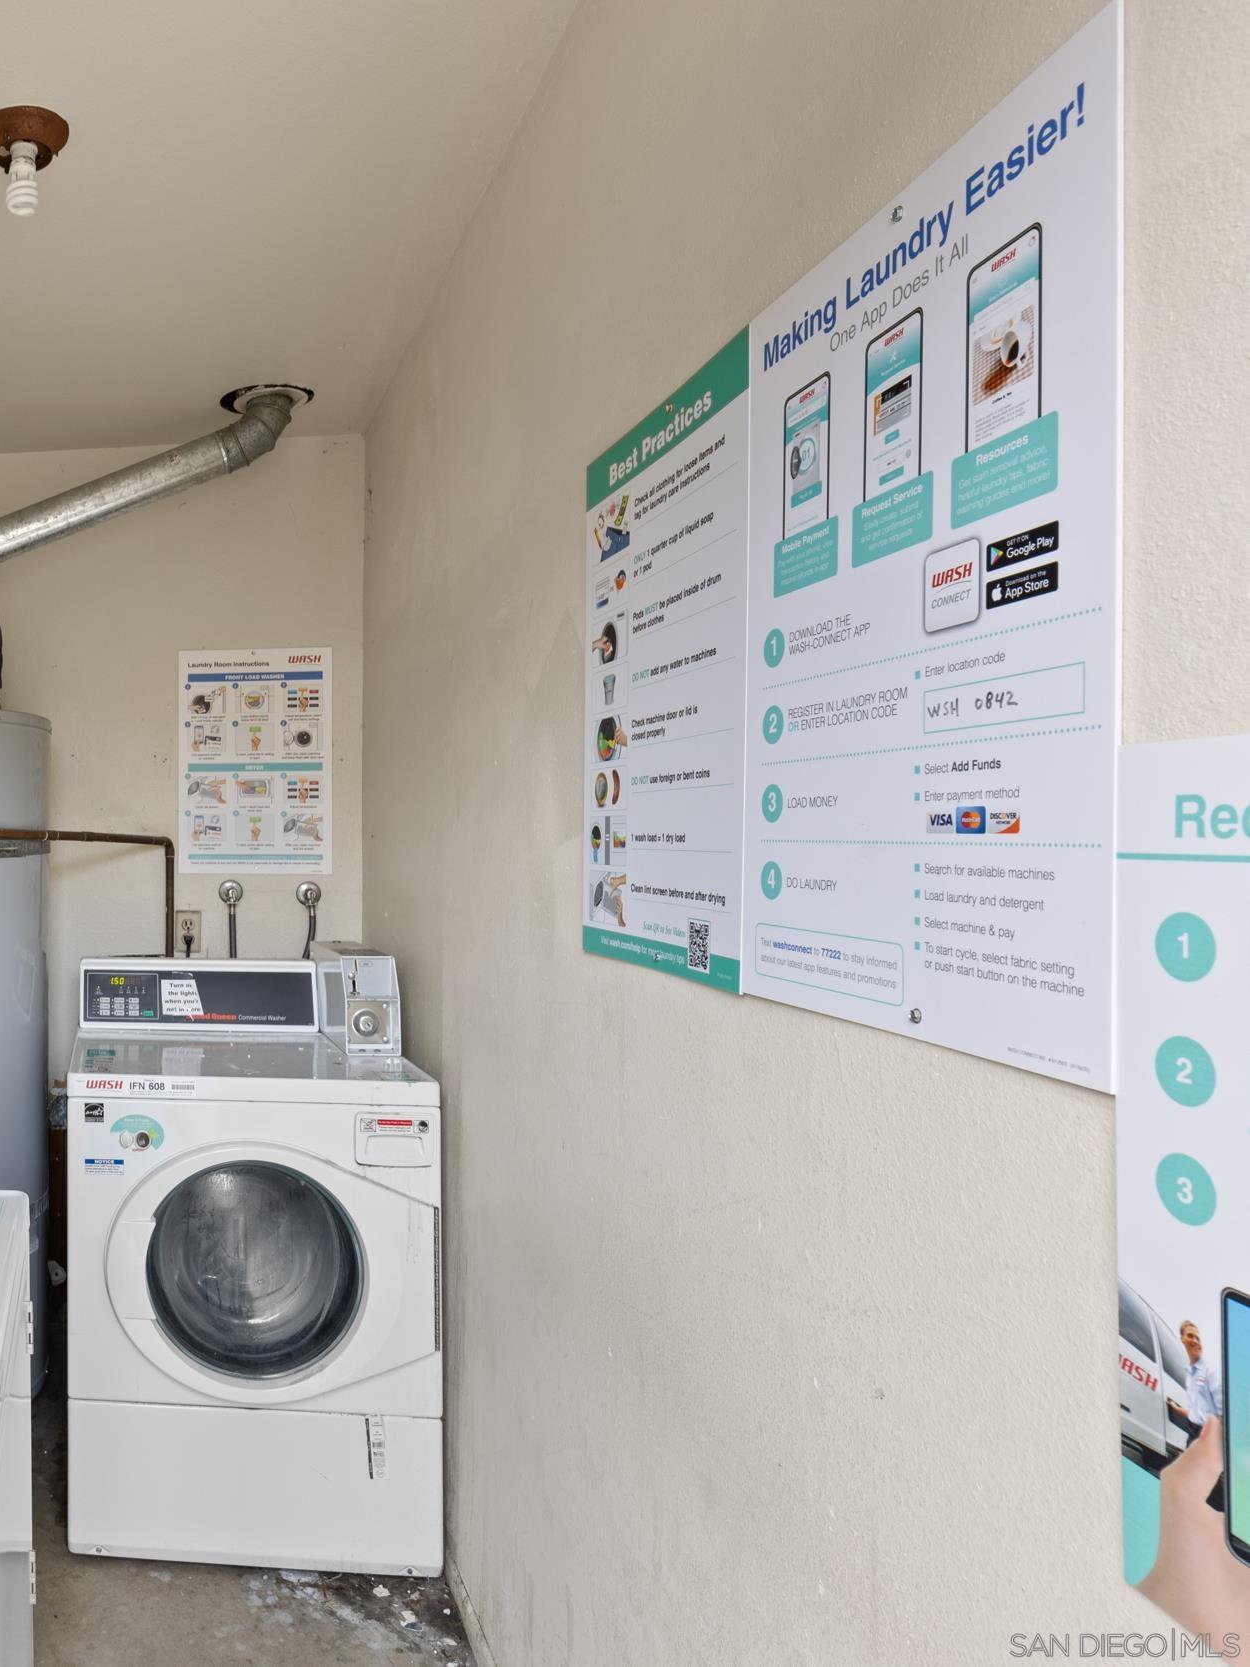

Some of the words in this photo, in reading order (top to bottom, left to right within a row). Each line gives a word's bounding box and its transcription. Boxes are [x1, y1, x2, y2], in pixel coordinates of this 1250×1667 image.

[763, 295, 838, 372] Making
[846, 201, 954, 310] Laundry
[965, 82, 1085, 216] Easier!
[829, 323, 857, 352] One
[860, 299, 887, 331] App
[891, 268, 930, 308] Does
[935, 254, 944, 277] It
[949, 233, 969, 267] All
[609, 447, 639, 487] Best
[642, 390, 712, 463] Practices
[976, 435, 1028, 466] Resources
[634, 492, 648, 507] Check
[656, 472, 675, 494] clothing
[684, 457, 698, 475] loose
[699, 445, 713, 462] items
[715, 434, 725, 451] and
[893, 484, 923, 504] Service
[650, 541, 667, 556] quarter
[669, 534, 678, 545] cup
[685, 519, 699, 537] liquid
[700, 512, 714, 527] soap
[932, 562, 972, 588] WASH
[633, 609, 644, 621] Pods
[666, 590, 682, 608] placed
[684, 584, 699, 598] inside
[700, 579, 706, 590] of
[707, 573, 721, 587] drum
[931, 589, 971, 609] CONNECT
[633, 622, 646, 634] before
[647, 614, 664, 630] clothes
[789, 620, 833, 643] DOWNLOAD
[836, 614, 851, 628] THE
[789, 628, 852, 656] WASH-CONNECT
[853, 623, 871, 637] APP
[288, 655, 322, 664] WASH
[925, 665, 945, 678] Enter
[947, 658, 980, 672] location
[982, 652, 1005, 666] code
[788, 703, 824, 720] REGISTER
[826, 701, 834, 712] IN
[836, 691, 876, 711] LAUNDRY
[879, 686, 908, 702] ROOM
[927, 698, 959, 718] WSH
[975, 691, 1018, 710] 0842
[788, 722, 799, 732] OR
[801, 717, 826, 731] ENTER
[828, 710, 870, 726] LOCATION
[871, 704, 898, 719] CODE
[631, 730, 646, 741] closed
[647, 727, 665, 739] properly
[924, 763, 949, 775] Select
[951, 761, 969, 773] Add
[971, 759, 1001, 771] Funds
[787, 797, 808, 809] LOAD
[809, 796, 838, 808] MONEY
[924, 791, 945, 802] Enter
[947, 789, 983, 803] payment
[985, 787, 1020, 799] method
[930, 814, 953, 826] VISA
[1175, 794, 1250, 839] Re
[924, 863, 952, 875] Search
[954, 864, 965, 875] for
[967, 866, 1005, 878] available
[1008, 868, 1055, 880] machines
[631, 883, 643, 893] Clean
[652, 887, 668, 896] screen
[669, 888, 683, 898] before
[685, 889, 694, 900] and
[695, 891, 707, 901] after
[708, 892, 725, 906] drying
[925, 889, 944, 901] Load
[947, 891, 977, 907] laundry
[979, 895, 996, 907] and
[999, 896, 1044, 912] detergent
[1177, 932, 1190, 959] 1
[925, 942, 934, 953] To
[936, 944, 953, 957] start
[955, 949, 979, 962] cycle,
[982, 952, 1008, 966] select
[1011, 955, 1038, 970] fabric
[1041, 960, 1075, 979] setting
[1176, 1057, 1193, 1084] 2
[86, 1080, 123, 1089] WASH
[149, 1082, 165, 1090] 608
[1176, 1177, 1194, 1204] 3
[1119, 1354, 1158, 1391] ASH
